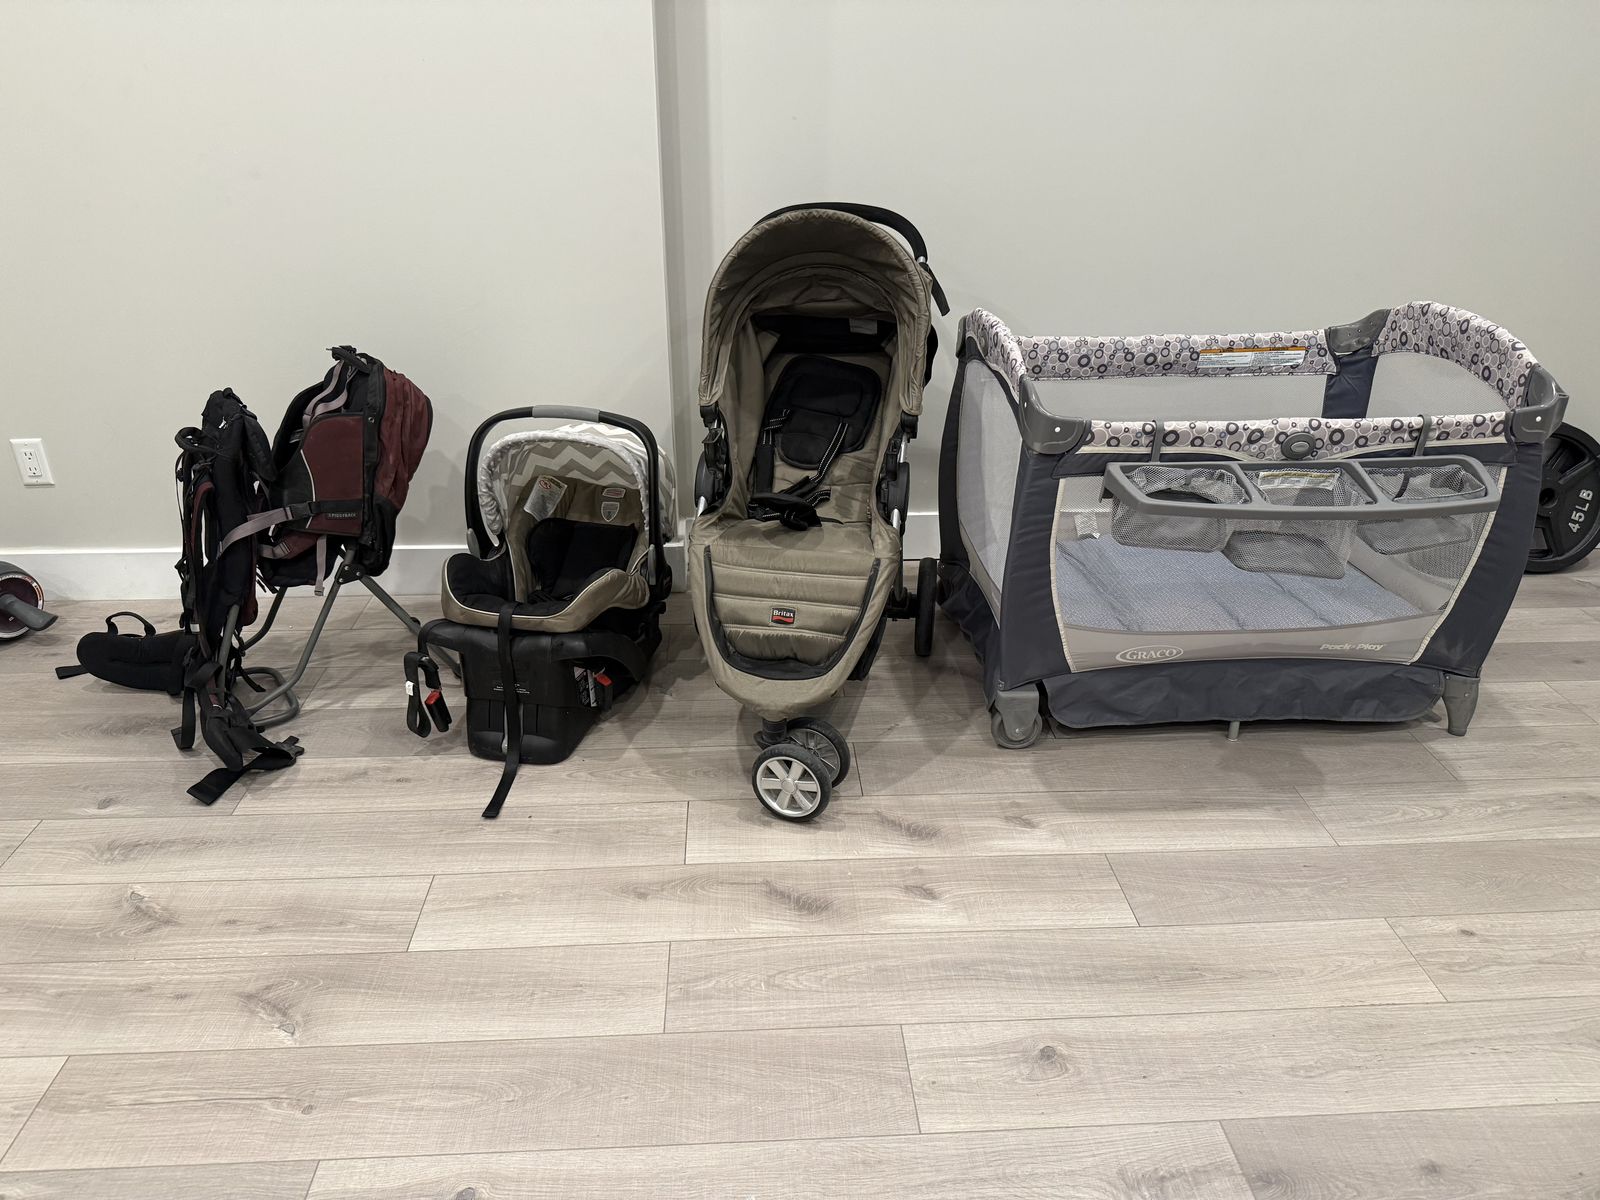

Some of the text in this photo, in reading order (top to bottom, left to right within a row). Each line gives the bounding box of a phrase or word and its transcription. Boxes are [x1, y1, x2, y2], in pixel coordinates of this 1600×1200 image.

[1568, 489, 1593, 533] 45LB
[773, 609, 794, 618] Britax
[1355, 643, 1384, 651] Play
[1126, 648, 1178, 660] GRACO
